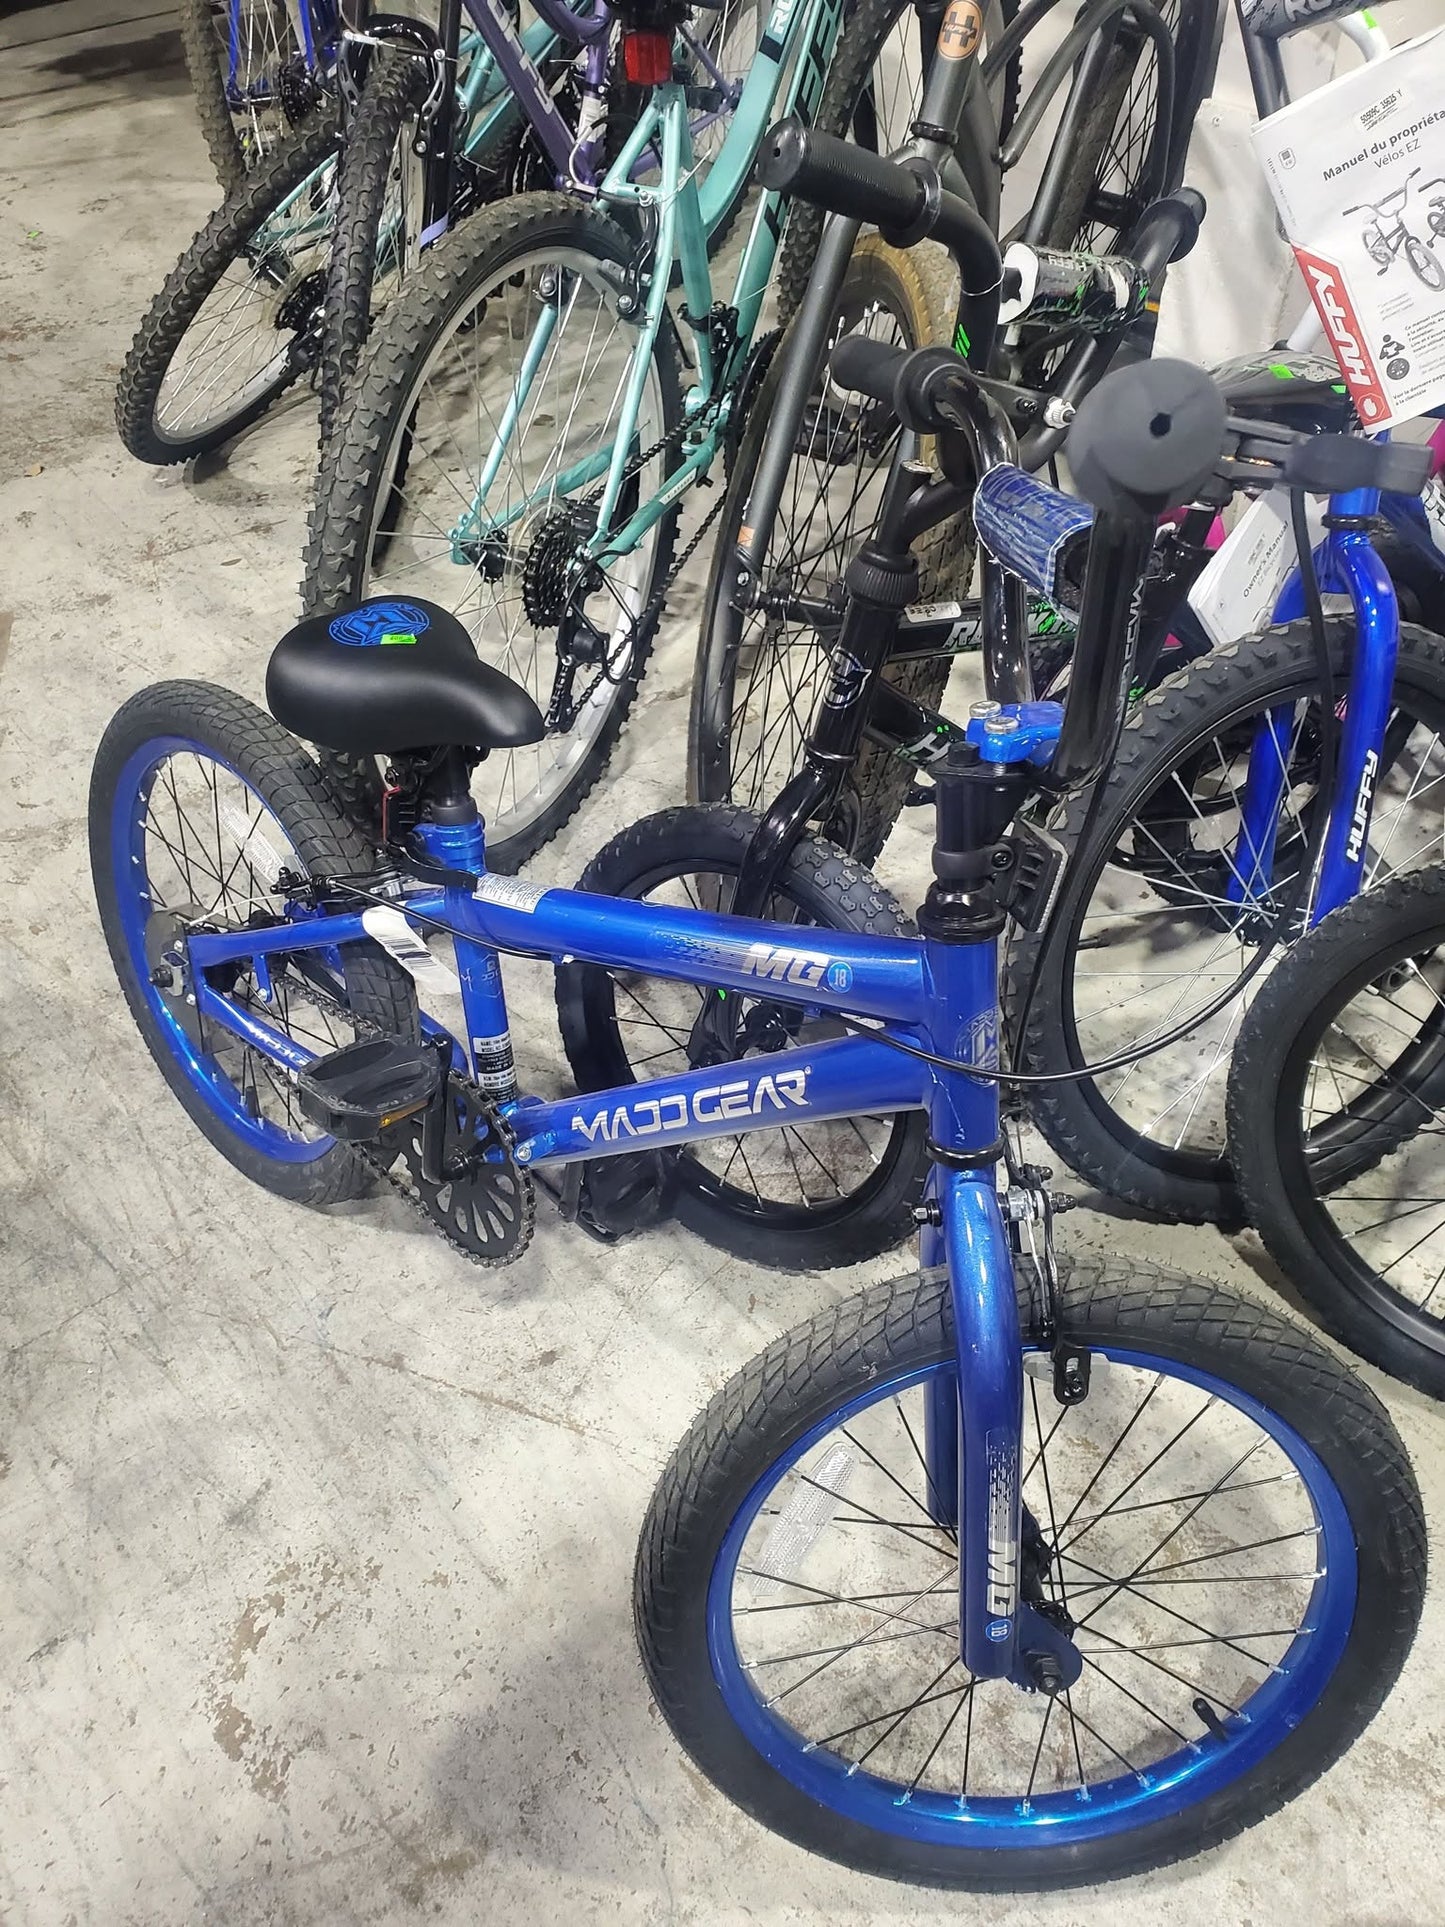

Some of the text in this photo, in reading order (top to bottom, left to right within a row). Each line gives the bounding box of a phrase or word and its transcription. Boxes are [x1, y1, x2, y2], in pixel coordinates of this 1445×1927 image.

[1322, 148, 1369, 182] Manuel
[1370, 140, 1387, 155] du
[1374, 138, 1422, 169] Vélos EZ
[1307, 264, 1373, 386] HUFFY
[1346, 749, 1378, 863] HUFFY
[740, 942, 830, 988] MG
[571, 1069, 811, 1142] MADD GEAR
